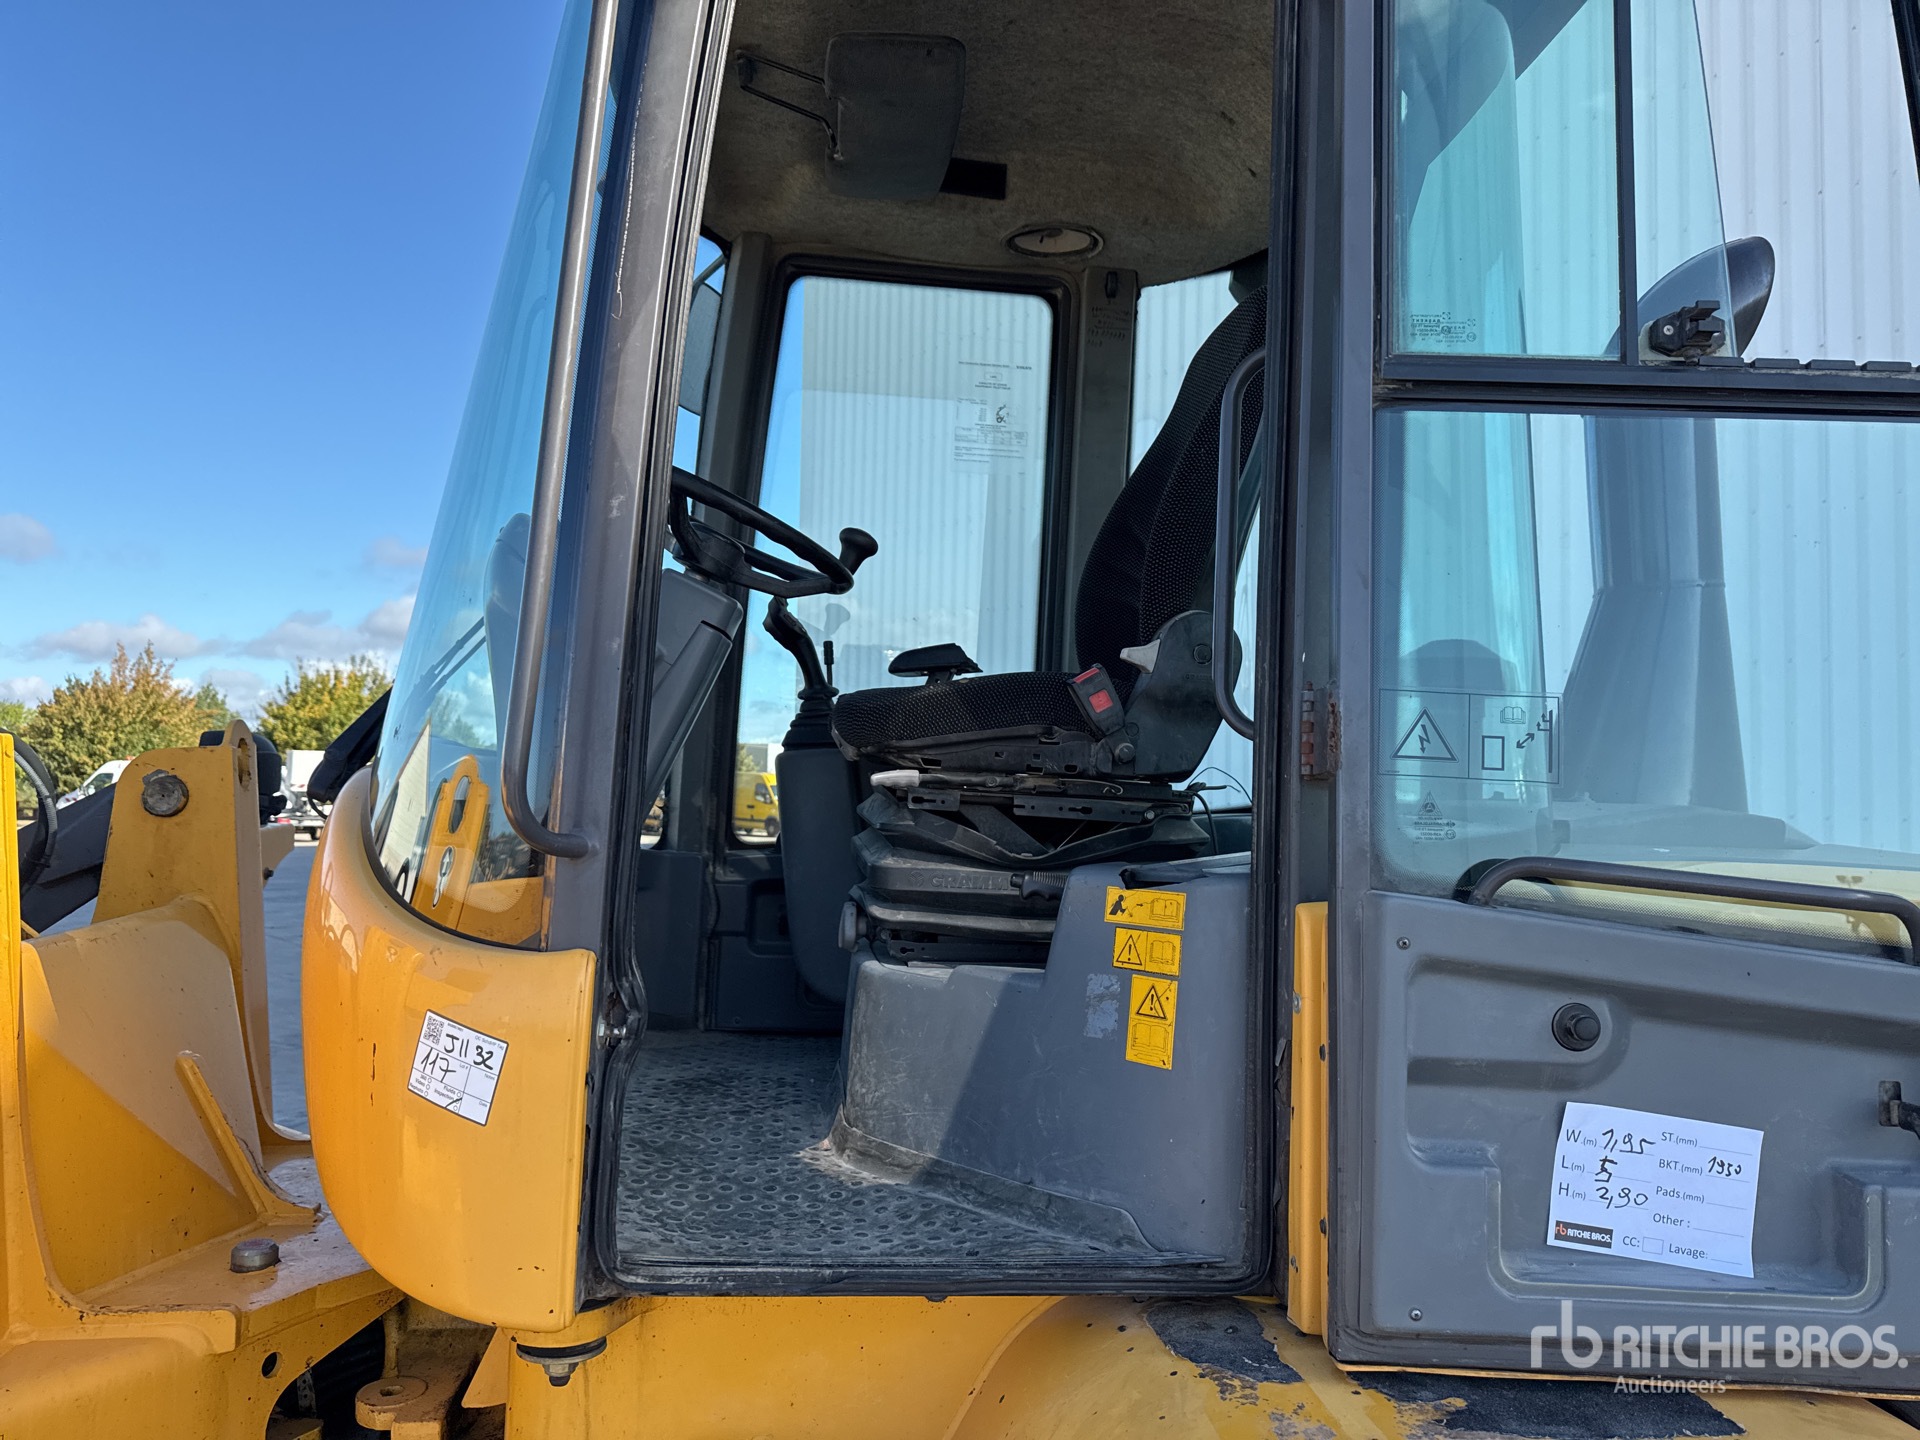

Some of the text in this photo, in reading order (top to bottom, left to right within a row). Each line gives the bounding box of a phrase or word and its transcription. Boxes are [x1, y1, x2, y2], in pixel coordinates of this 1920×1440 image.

[930, 873, 1010, 890] GRAMM
[420, 1047, 457, 1083] 117
[1652, 1212, 1685, 1228] Other
[1567, 1228, 1591, 1240] RITCHIE
[1622, 1235, 1640, 1248] CC:
